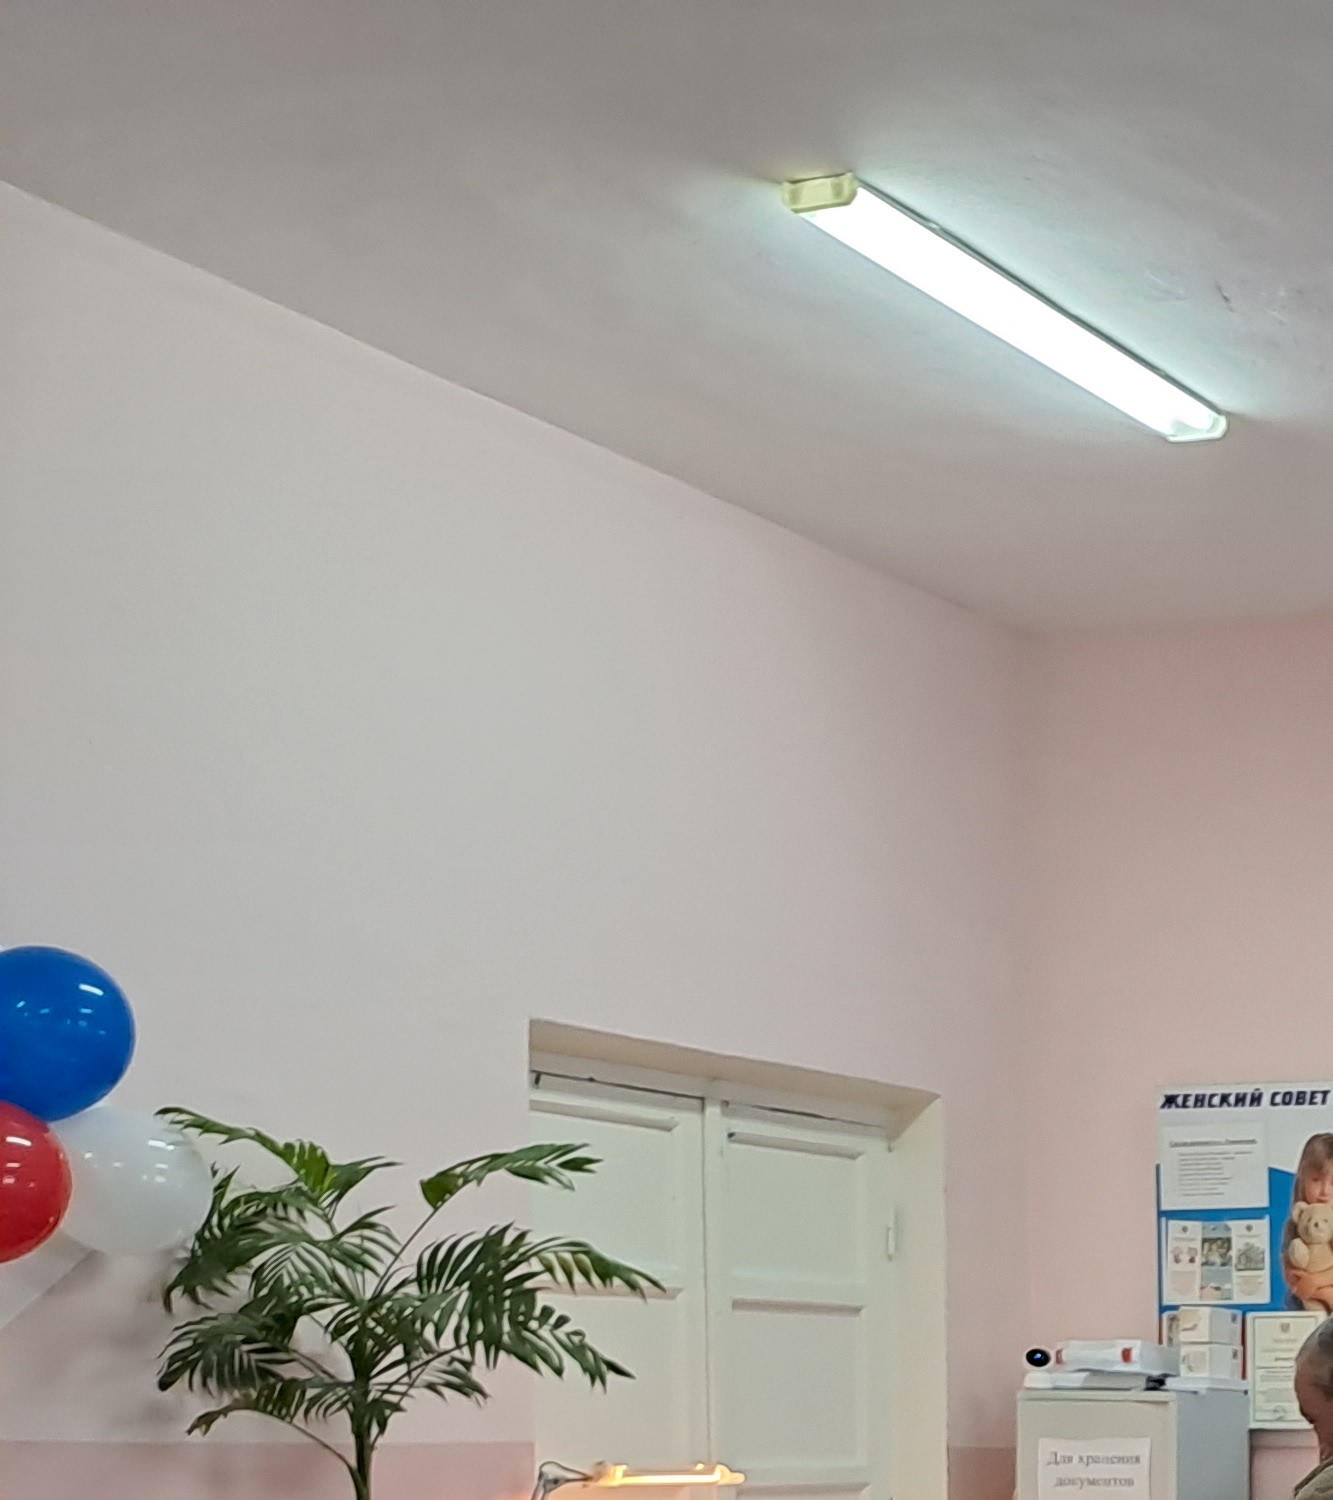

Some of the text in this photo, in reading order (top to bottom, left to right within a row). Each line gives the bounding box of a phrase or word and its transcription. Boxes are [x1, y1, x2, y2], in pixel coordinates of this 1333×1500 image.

[1159, 1087, 1264, 1110] ЖЕНСКИЙ
[1269, 1089, 1332, 1107] СОВЕТ
[1046, 1451, 1141, 1467] Для хранения
[1053, 1476, 1135, 1491] документов
